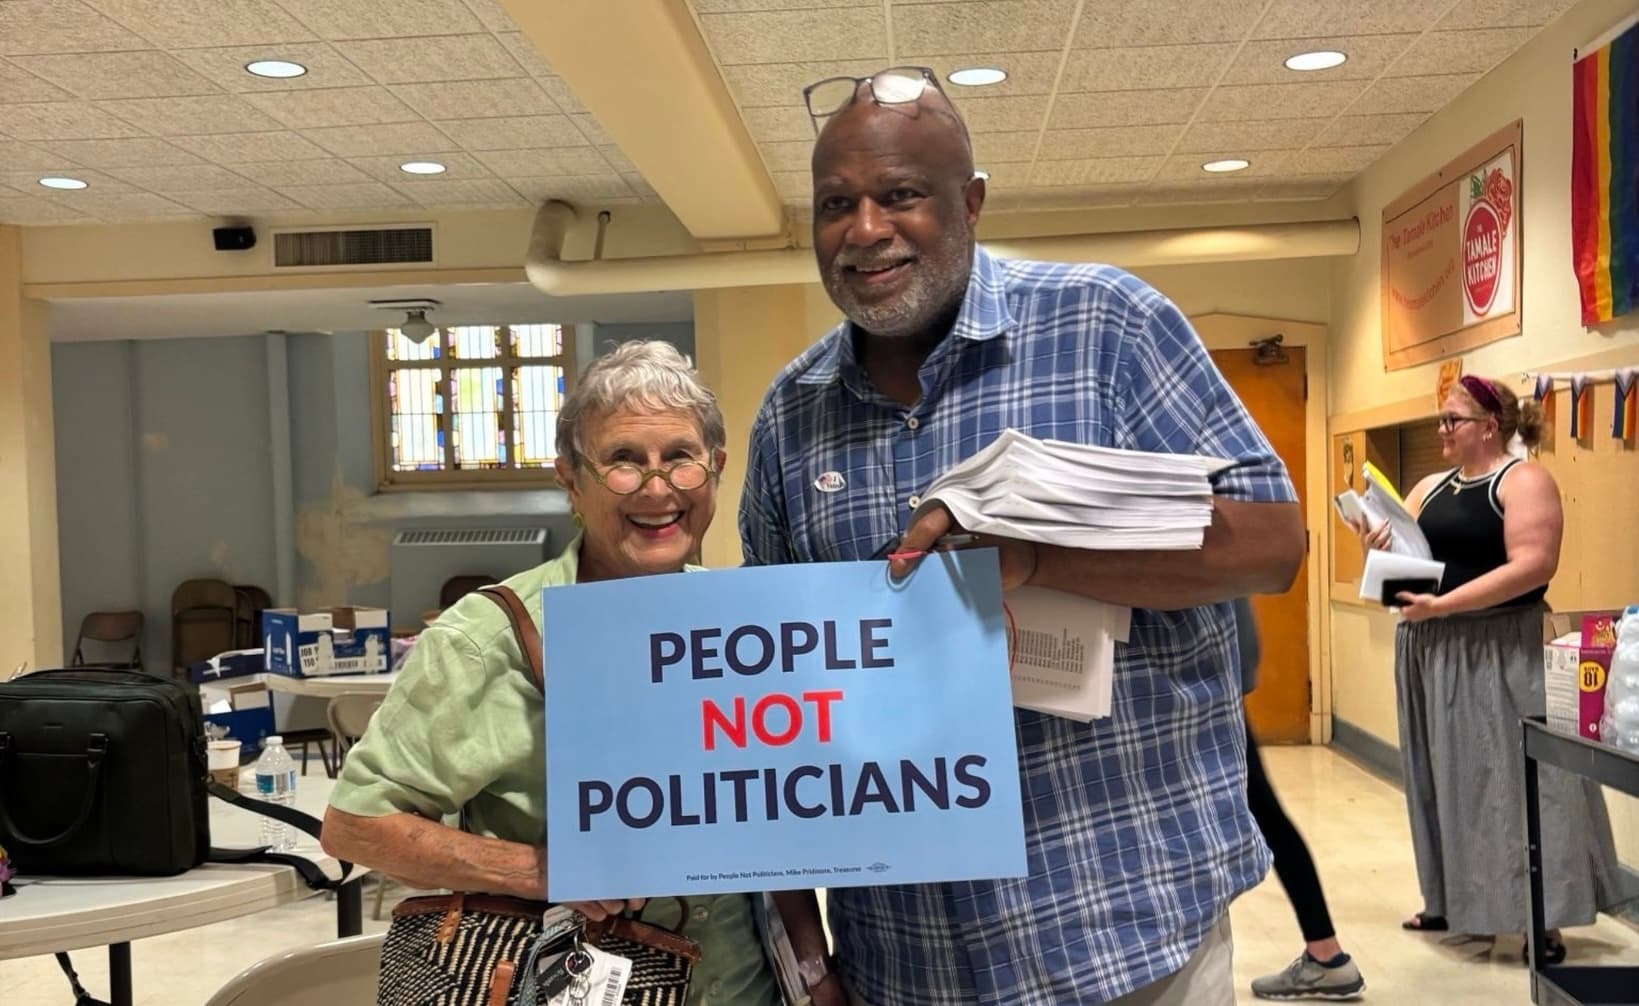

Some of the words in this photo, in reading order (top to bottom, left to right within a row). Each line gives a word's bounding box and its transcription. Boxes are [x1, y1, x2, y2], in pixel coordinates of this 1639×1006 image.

[1466, 229, 1497, 262] TAMALE
[1467, 254, 1497, 287] KITCHEN
[650, 618, 895, 683] PEOPLE
[701, 690, 844, 751] NOT
[577, 754, 992, 833] POLITICIANS
[700, 873, 709, 881] for
[710, 873, 718, 881] by
[718, 872, 739, 880] People
[740, 871, 752, 879] Not
